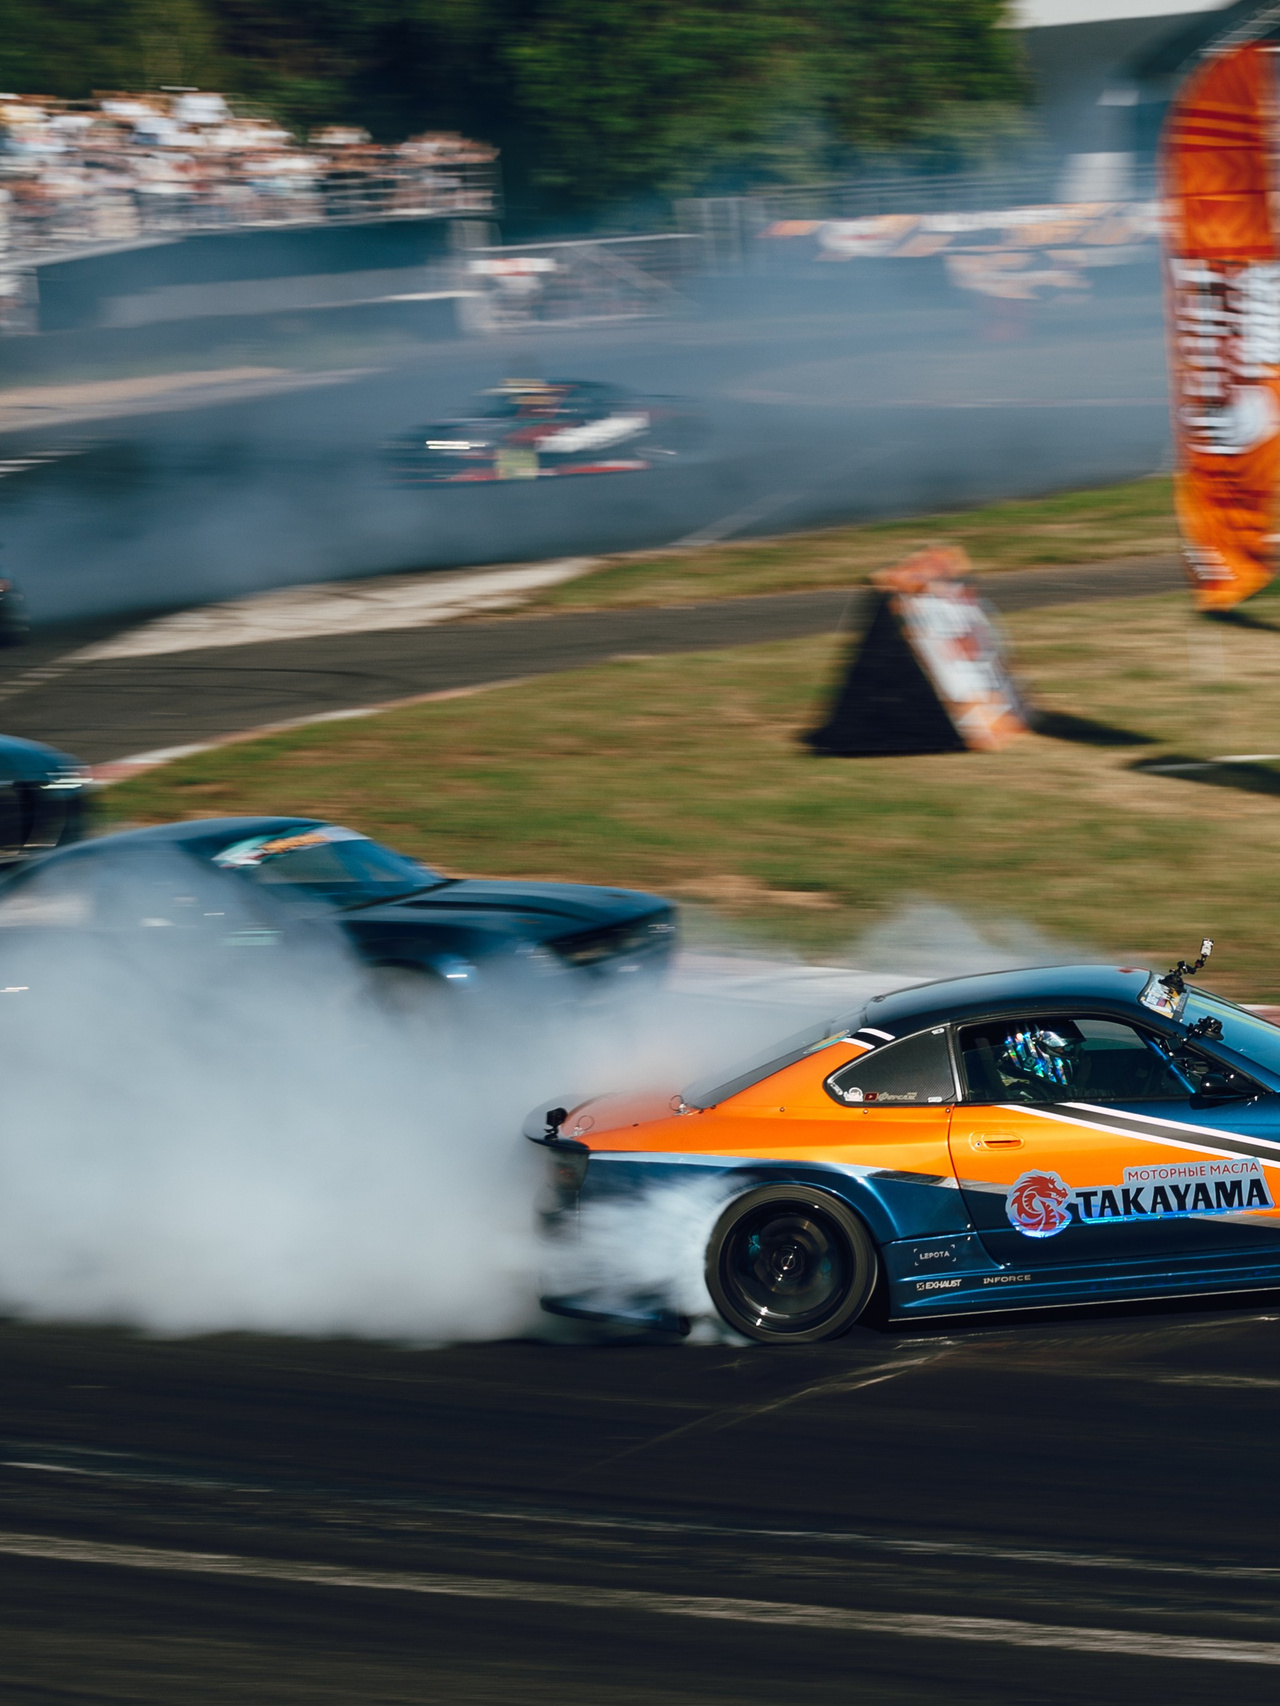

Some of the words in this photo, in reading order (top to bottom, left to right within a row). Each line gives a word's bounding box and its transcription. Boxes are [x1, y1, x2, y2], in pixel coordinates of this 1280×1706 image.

[1127, 1165, 1206, 1181] МОТОРНЫЕ
[1210, 1162, 1259, 1175] МАСЛА
[1075, 1178, 1271, 1218] TAKAYAMA
[919, 1251, 950, 1260] LEPOTA
[925, 1279, 962, 1290] EXHAUST
[983, 1275, 1031, 1284] INFORCE
